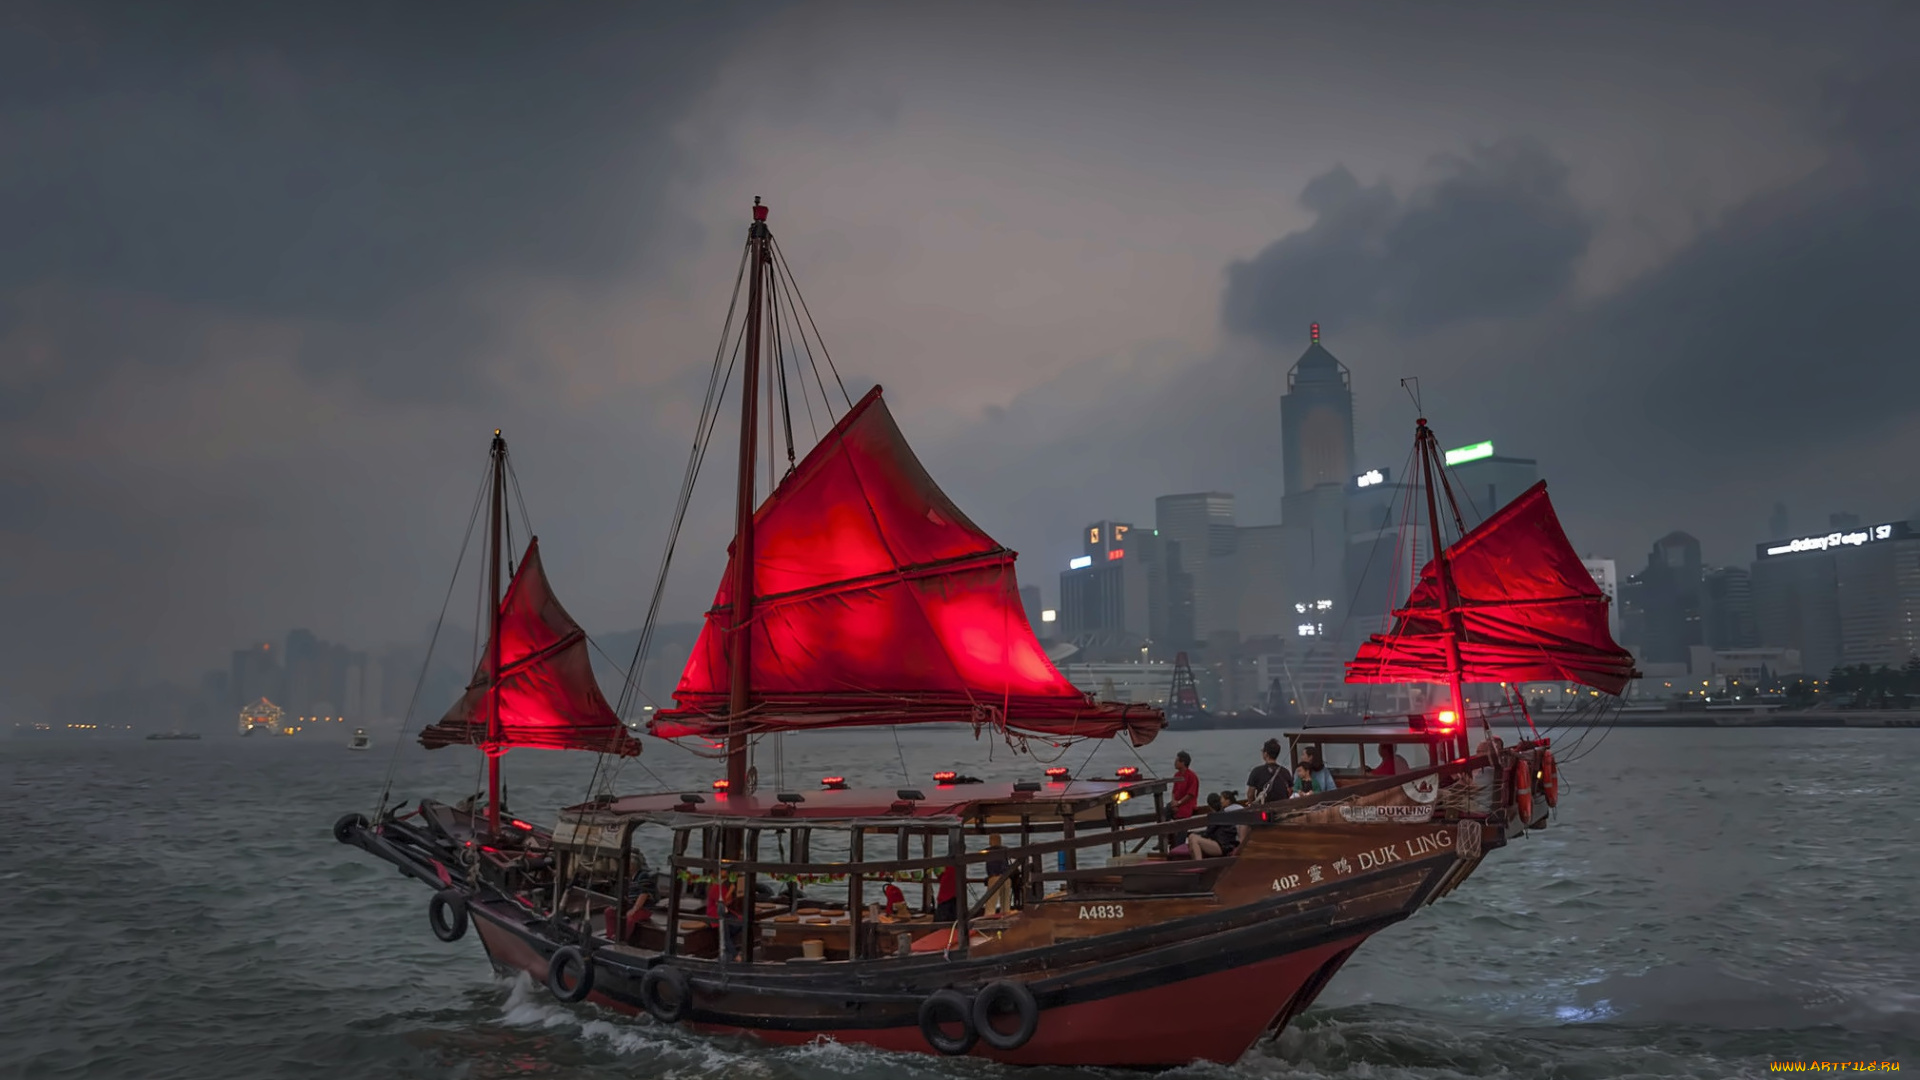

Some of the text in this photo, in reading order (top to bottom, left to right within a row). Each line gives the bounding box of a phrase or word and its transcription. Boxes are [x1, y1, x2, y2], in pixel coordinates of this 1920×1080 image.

[1828, 532, 1842, 546] S7
[1875, 525, 1892, 539] S7
[1378, 805, 1433, 817] DUKLING
[1357, 844, 1401, 870] DUK
[1405, 829, 1452, 857] LING
[1079, 904, 1125, 919] A4833
